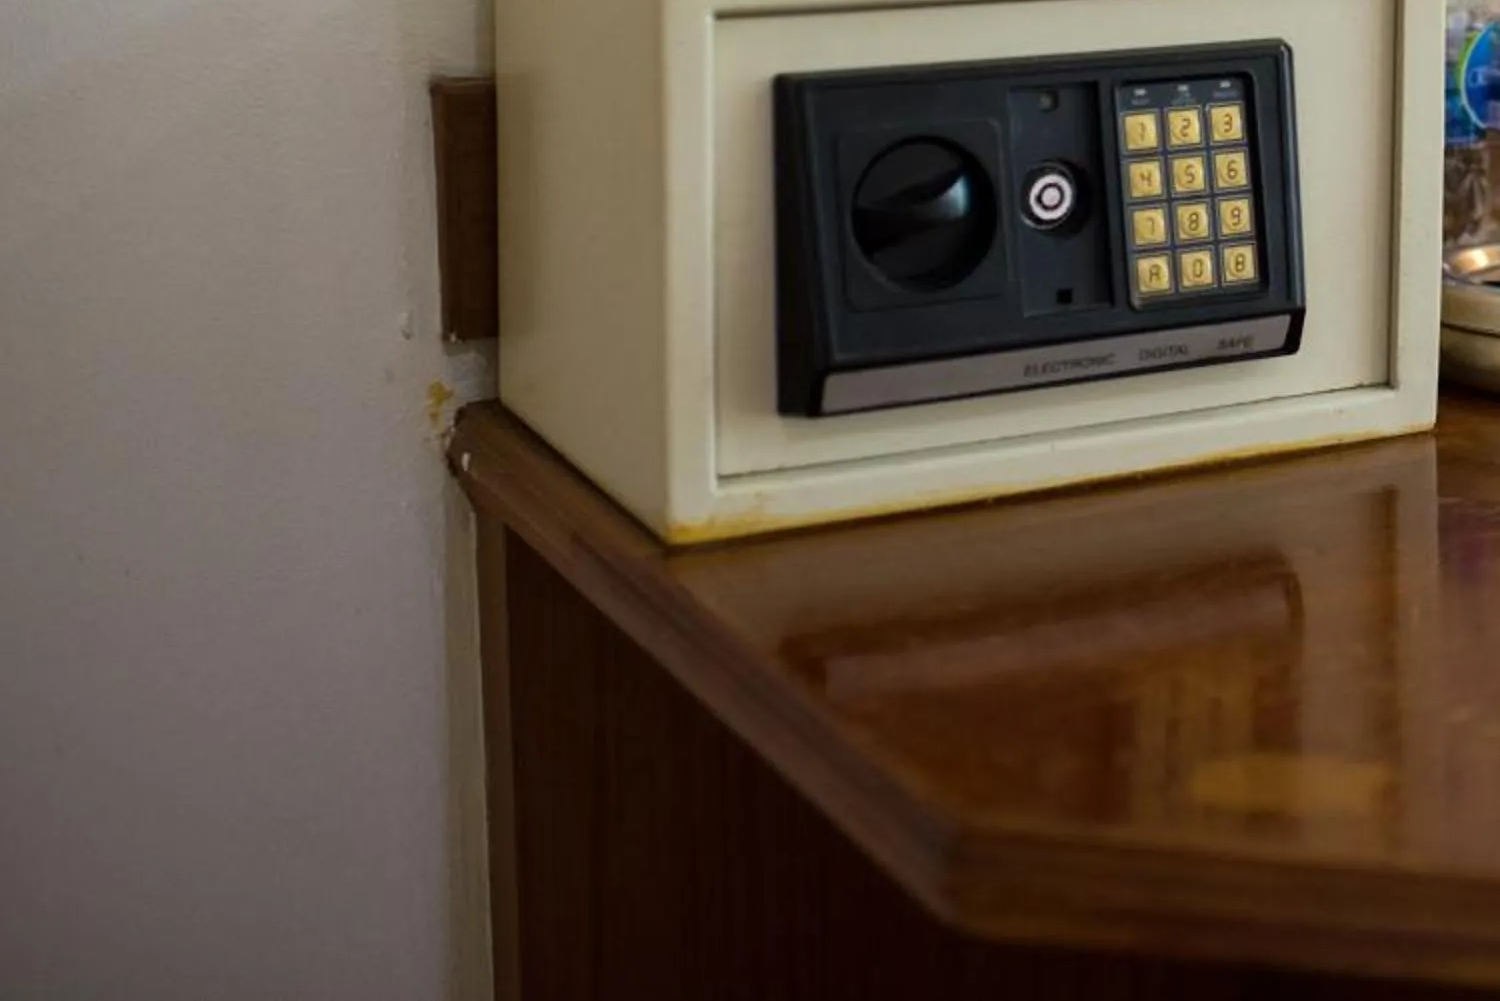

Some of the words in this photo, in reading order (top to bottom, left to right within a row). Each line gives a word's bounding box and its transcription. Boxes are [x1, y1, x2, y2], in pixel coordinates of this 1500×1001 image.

[1179, 117, 1192, 138] 2
[1223, 113, 1234, 133] 3
[1184, 164, 1196, 185] 5
[1226, 159, 1238, 180] 6
[1188, 211, 1200, 232] 8
[1230, 206, 1242, 227] 9
[1023, 353, 1117, 378] ELECTRONIC
[1216, 334, 1255, 350] SAFE
